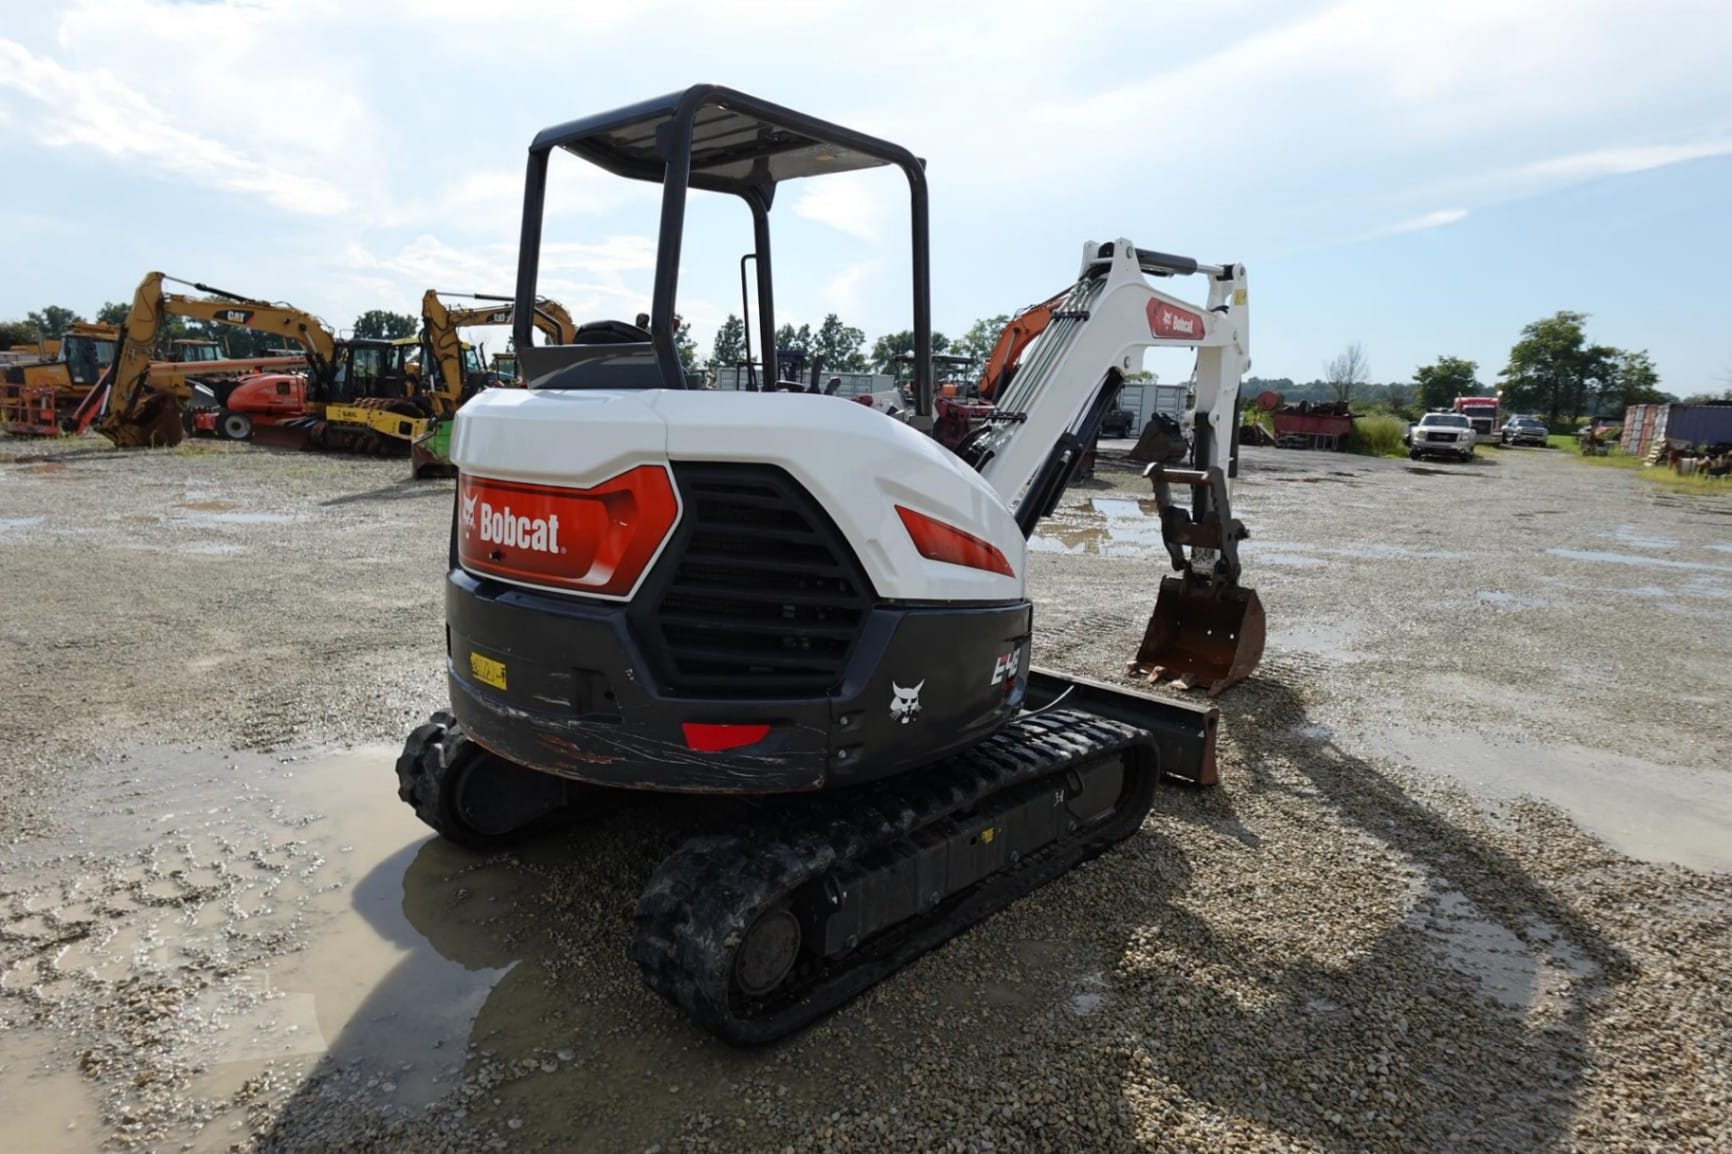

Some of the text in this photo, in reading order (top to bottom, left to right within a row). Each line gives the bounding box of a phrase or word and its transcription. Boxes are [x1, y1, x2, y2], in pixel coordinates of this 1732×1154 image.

[227, 310, 245, 323] CAT
[1173, 315, 1193, 334] Bobcat
[480, 502, 559, 554] Bobcat
